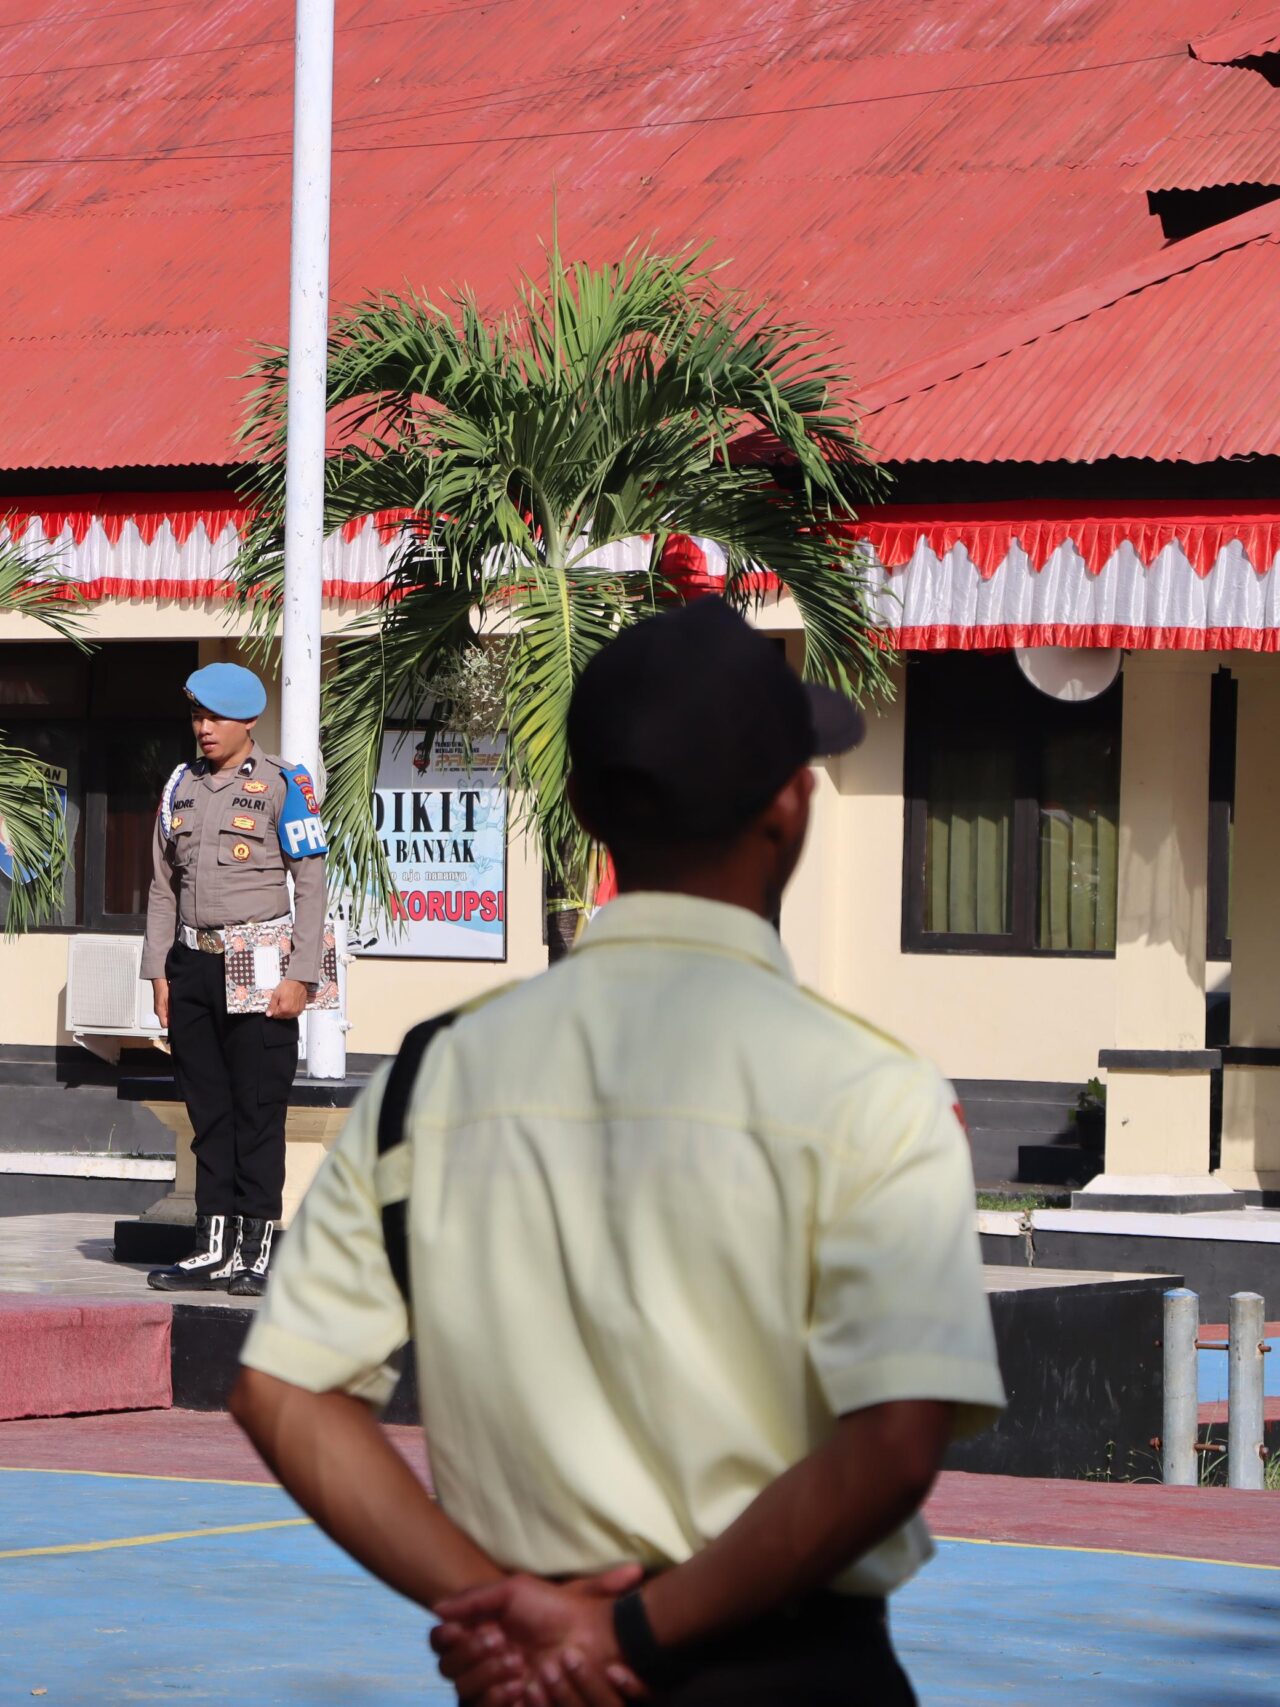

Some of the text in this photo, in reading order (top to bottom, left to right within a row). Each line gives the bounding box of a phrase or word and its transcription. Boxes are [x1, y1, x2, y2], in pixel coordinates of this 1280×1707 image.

[232, 797, 266, 811] POLRI
[396, 839, 475, 863] BANYAK
[402, 869, 420, 882] aja
[425, 872, 467, 882] namanya
[390, 890, 503, 922] KORUPSI
